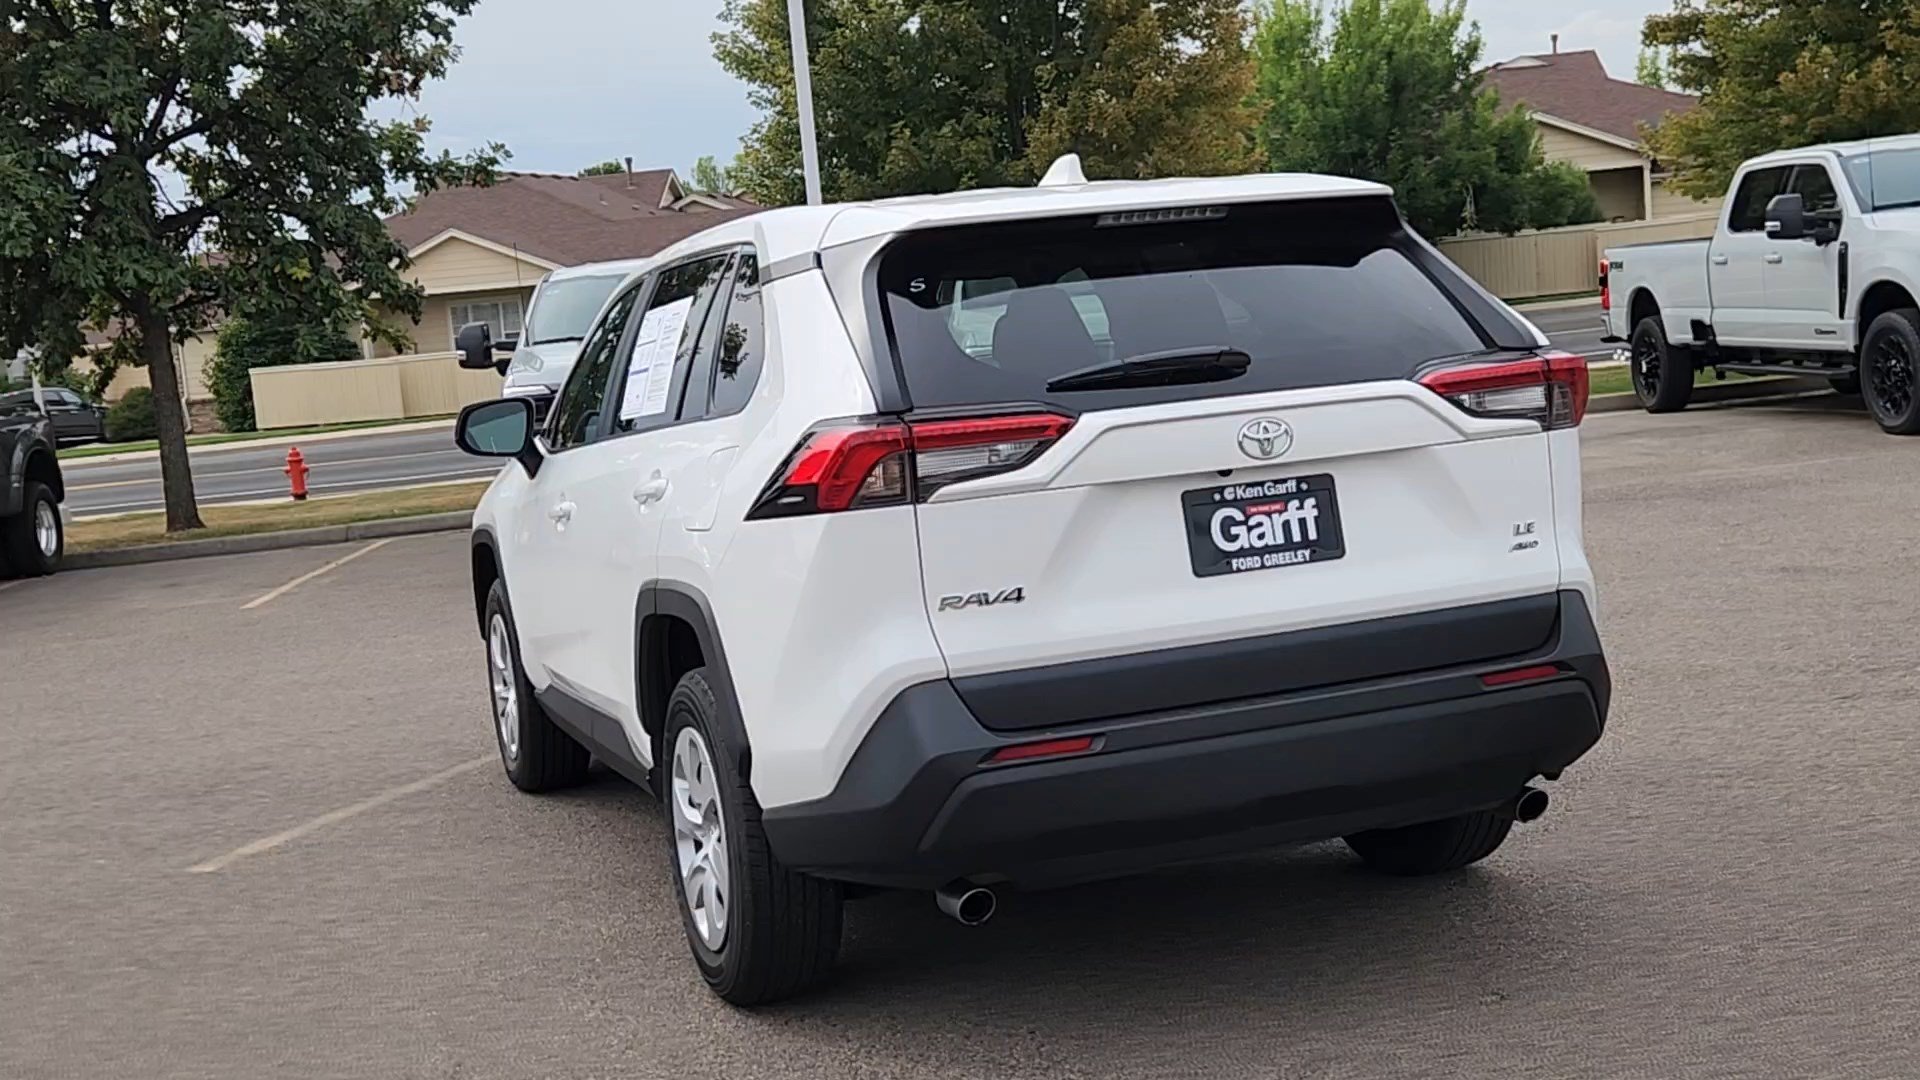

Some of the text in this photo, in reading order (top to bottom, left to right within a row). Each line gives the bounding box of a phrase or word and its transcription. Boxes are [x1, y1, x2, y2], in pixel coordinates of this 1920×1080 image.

[909, 277, 926, 293] S
[1236, 484, 1263, 500] Ken
[1263, 479, 1297, 496] Garff
[1210, 497, 1319, 553] Garff
[1512, 521, 1536, 537] LE
[1231, 548, 1311, 572] FORD GREELEY
[938, 586, 1025, 612] RAV4
